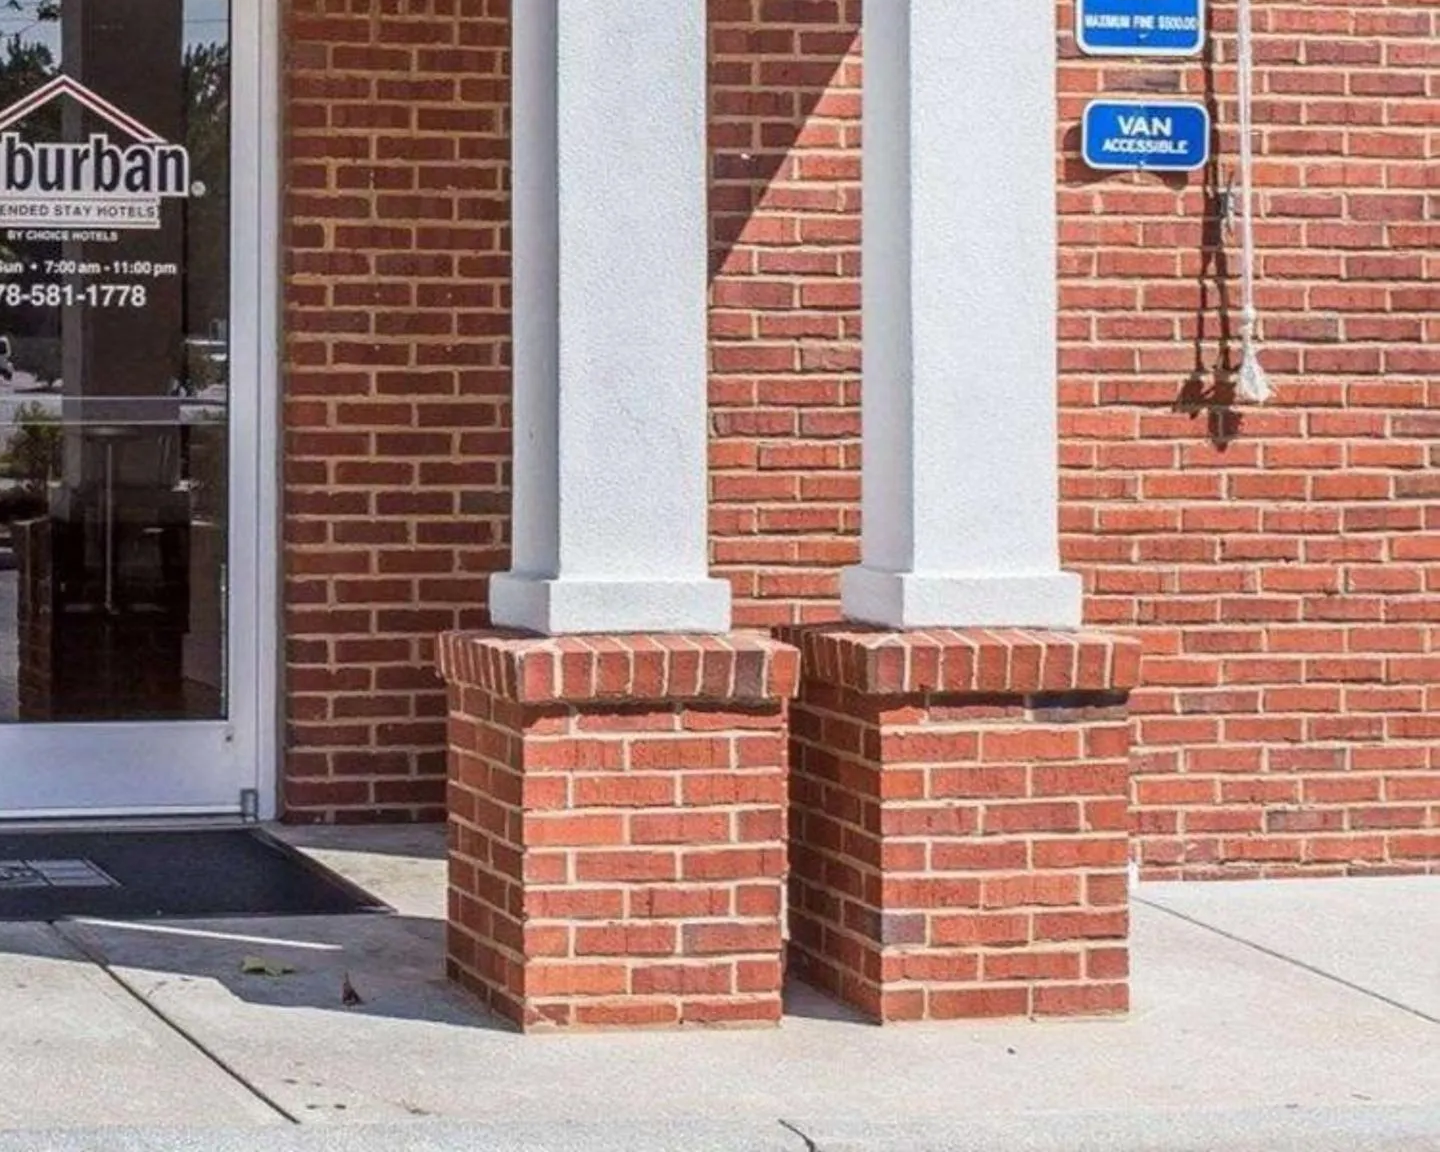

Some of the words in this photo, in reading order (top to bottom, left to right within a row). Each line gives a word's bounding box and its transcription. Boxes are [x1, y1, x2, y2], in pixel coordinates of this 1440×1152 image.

[1085, 14, 1130, 28] MAXIMUM
[1133, 14, 1154, 29] FINE
[1117, 115, 1172, 136] VAN
[1102, 139, 1188, 154] ACCESSIBLE
[54, 204, 92, 217] STAY
[97, 205, 156, 218] HOTELS
[7, 230, 23, 241] BY
[26, 230, 69, 242] CHOICE
[72, 231, 118, 243] HOTELS
